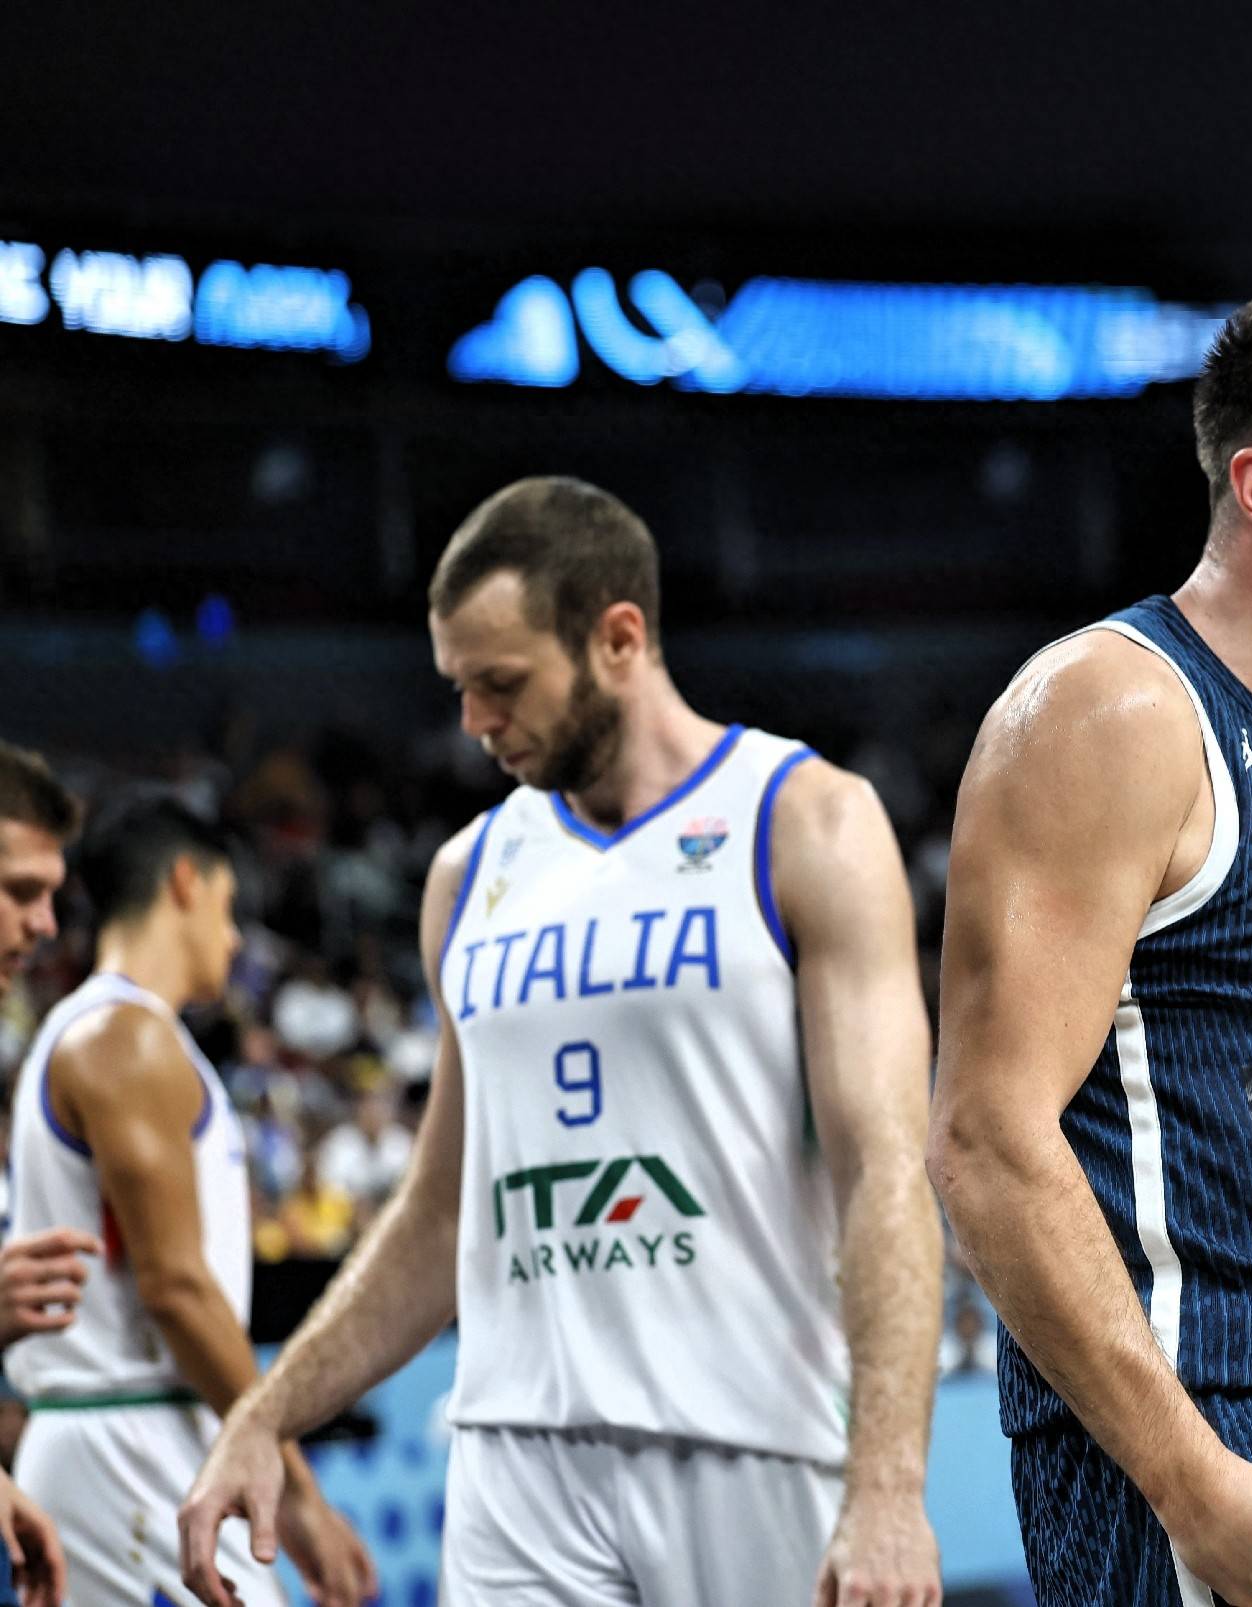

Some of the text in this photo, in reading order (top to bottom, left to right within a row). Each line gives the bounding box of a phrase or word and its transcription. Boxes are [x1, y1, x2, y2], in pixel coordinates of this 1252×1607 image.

[459, 906, 720, 1021] ITALIA
[554, 1039, 602, 1129] 9
[493, 1154, 706, 1240] ITA
[509, 1232, 696, 1286] AIRWAYS
